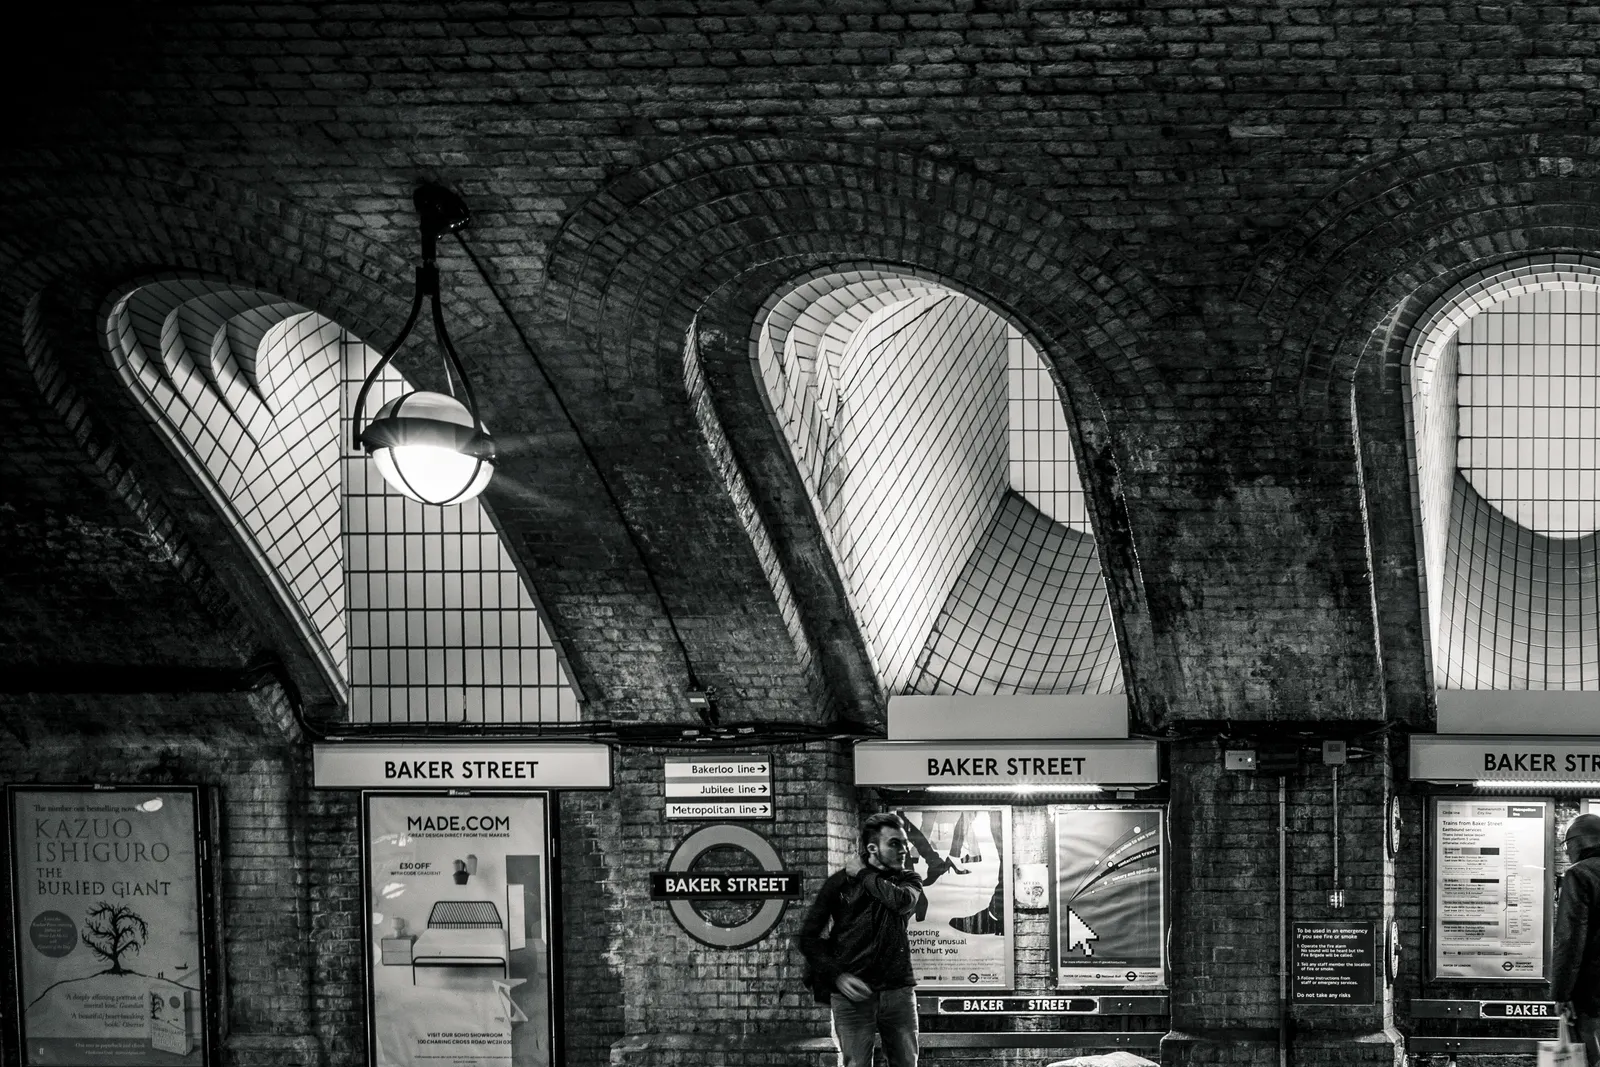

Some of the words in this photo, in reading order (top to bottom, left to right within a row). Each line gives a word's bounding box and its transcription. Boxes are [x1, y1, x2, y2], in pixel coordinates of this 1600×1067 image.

[385, 761, 454, 779] BAKER
[463, 761, 538, 779] STREET
[692, 765, 734, 774] Bakerloo
[738, 765, 755, 774] line
[928, 758, 998, 776] BAKER
[1007, 758, 1086, 776] STREET
[1484, 754, 1556, 773] BAKER
[700, 785, 734, 794] Jubilee
[738, 785, 756, 794] line
[672, 806, 735, 815] Metropolitan
[740, 806, 757, 814] line
[36, 818, 132, 838] KAZUO
[408, 816, 510, 831] MADE.COM
[36, 842, 170, 862] ISHIGURO
[1142, 848, 1156, 857] travel
[36, 868, 62, 878] THE
[38, 880, 105, 896] BURIED
[112, 880, 171, 898] GIANT
[665, 877, 721, 893] BAKER
[727, 877, 790, 893] STREET
[963, 1000, 1004, 1010] BAKER
[1028, 1000, 1072, 1010] STREET
[1505, 1004, 1548, 1016] BAKER
